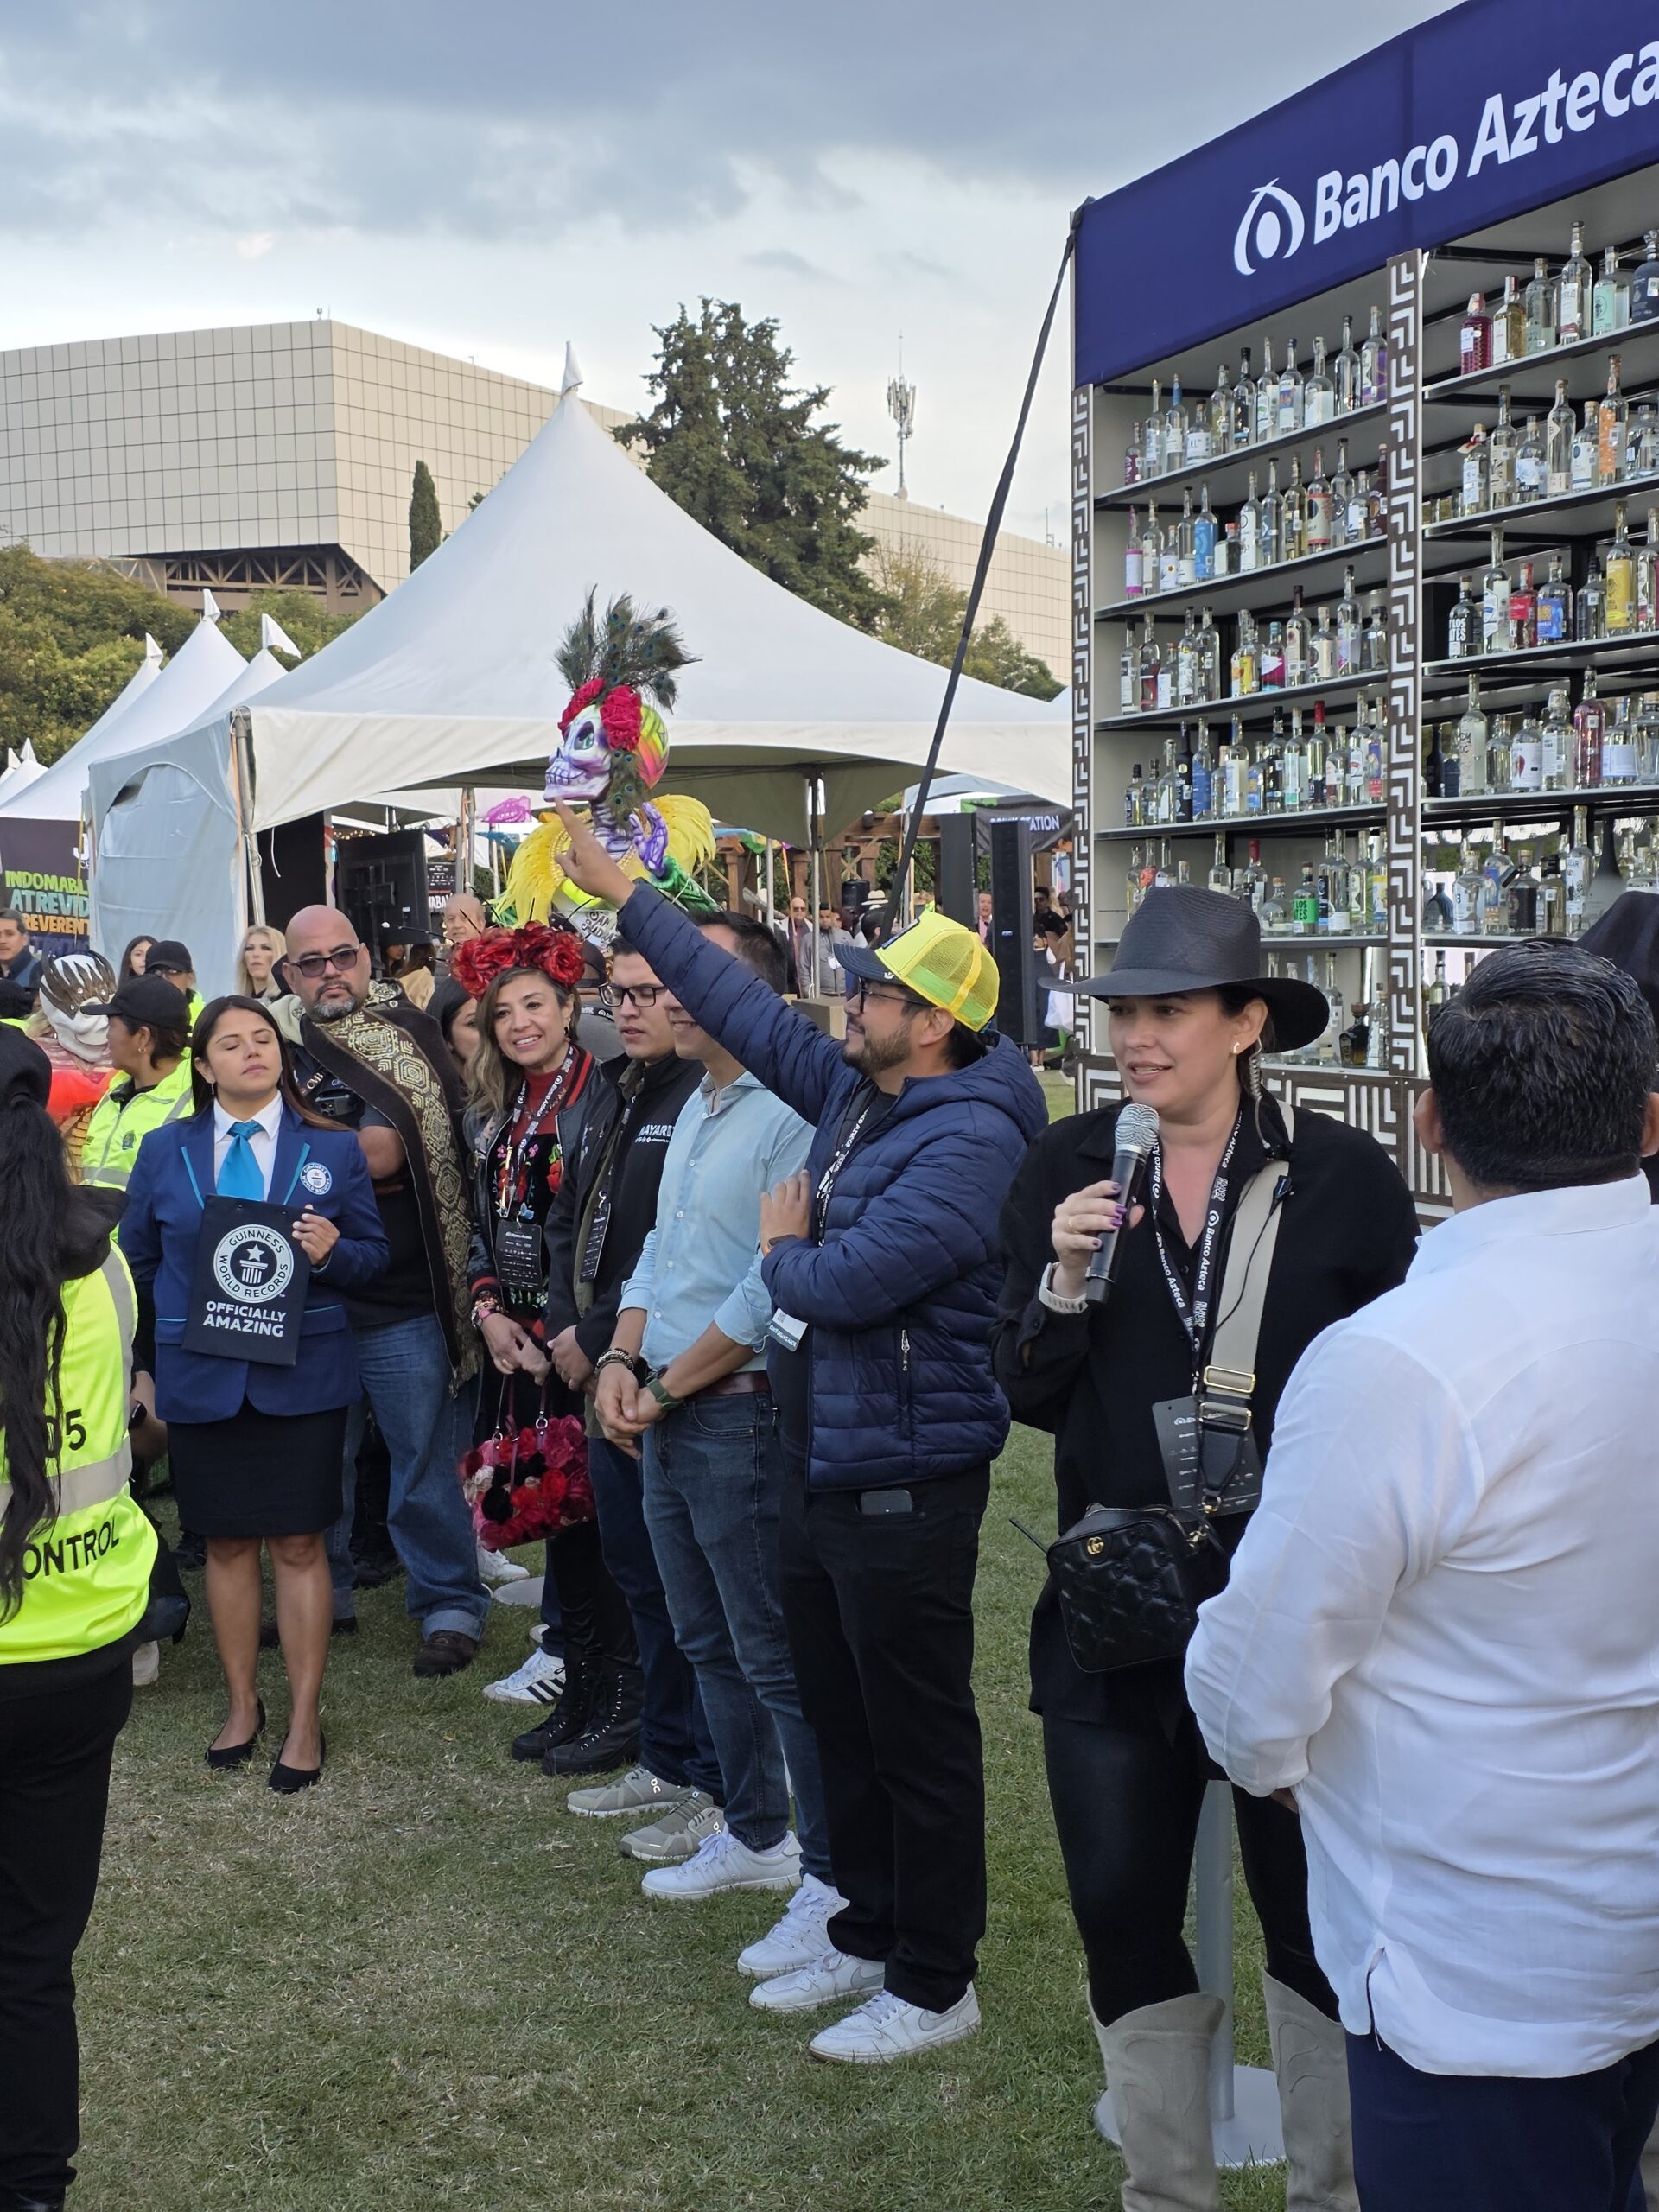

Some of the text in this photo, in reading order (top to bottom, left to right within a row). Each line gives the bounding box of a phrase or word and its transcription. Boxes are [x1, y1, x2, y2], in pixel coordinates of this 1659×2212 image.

[1313, 41, 1659, 245] Banco Azteca
[229, 1230, 285, 1254] GUINNESS
[1198, 1227, 1216, 1291] Banco Azteca
[219, 1255, 289, 1298] WORLD RECORDS
[1160, 1247, 1185, 1309] Banco Azteca
[202, 1313, 284, 1338] AMAZING
[206, 1300, 287, 1323] OFFICIALLY
